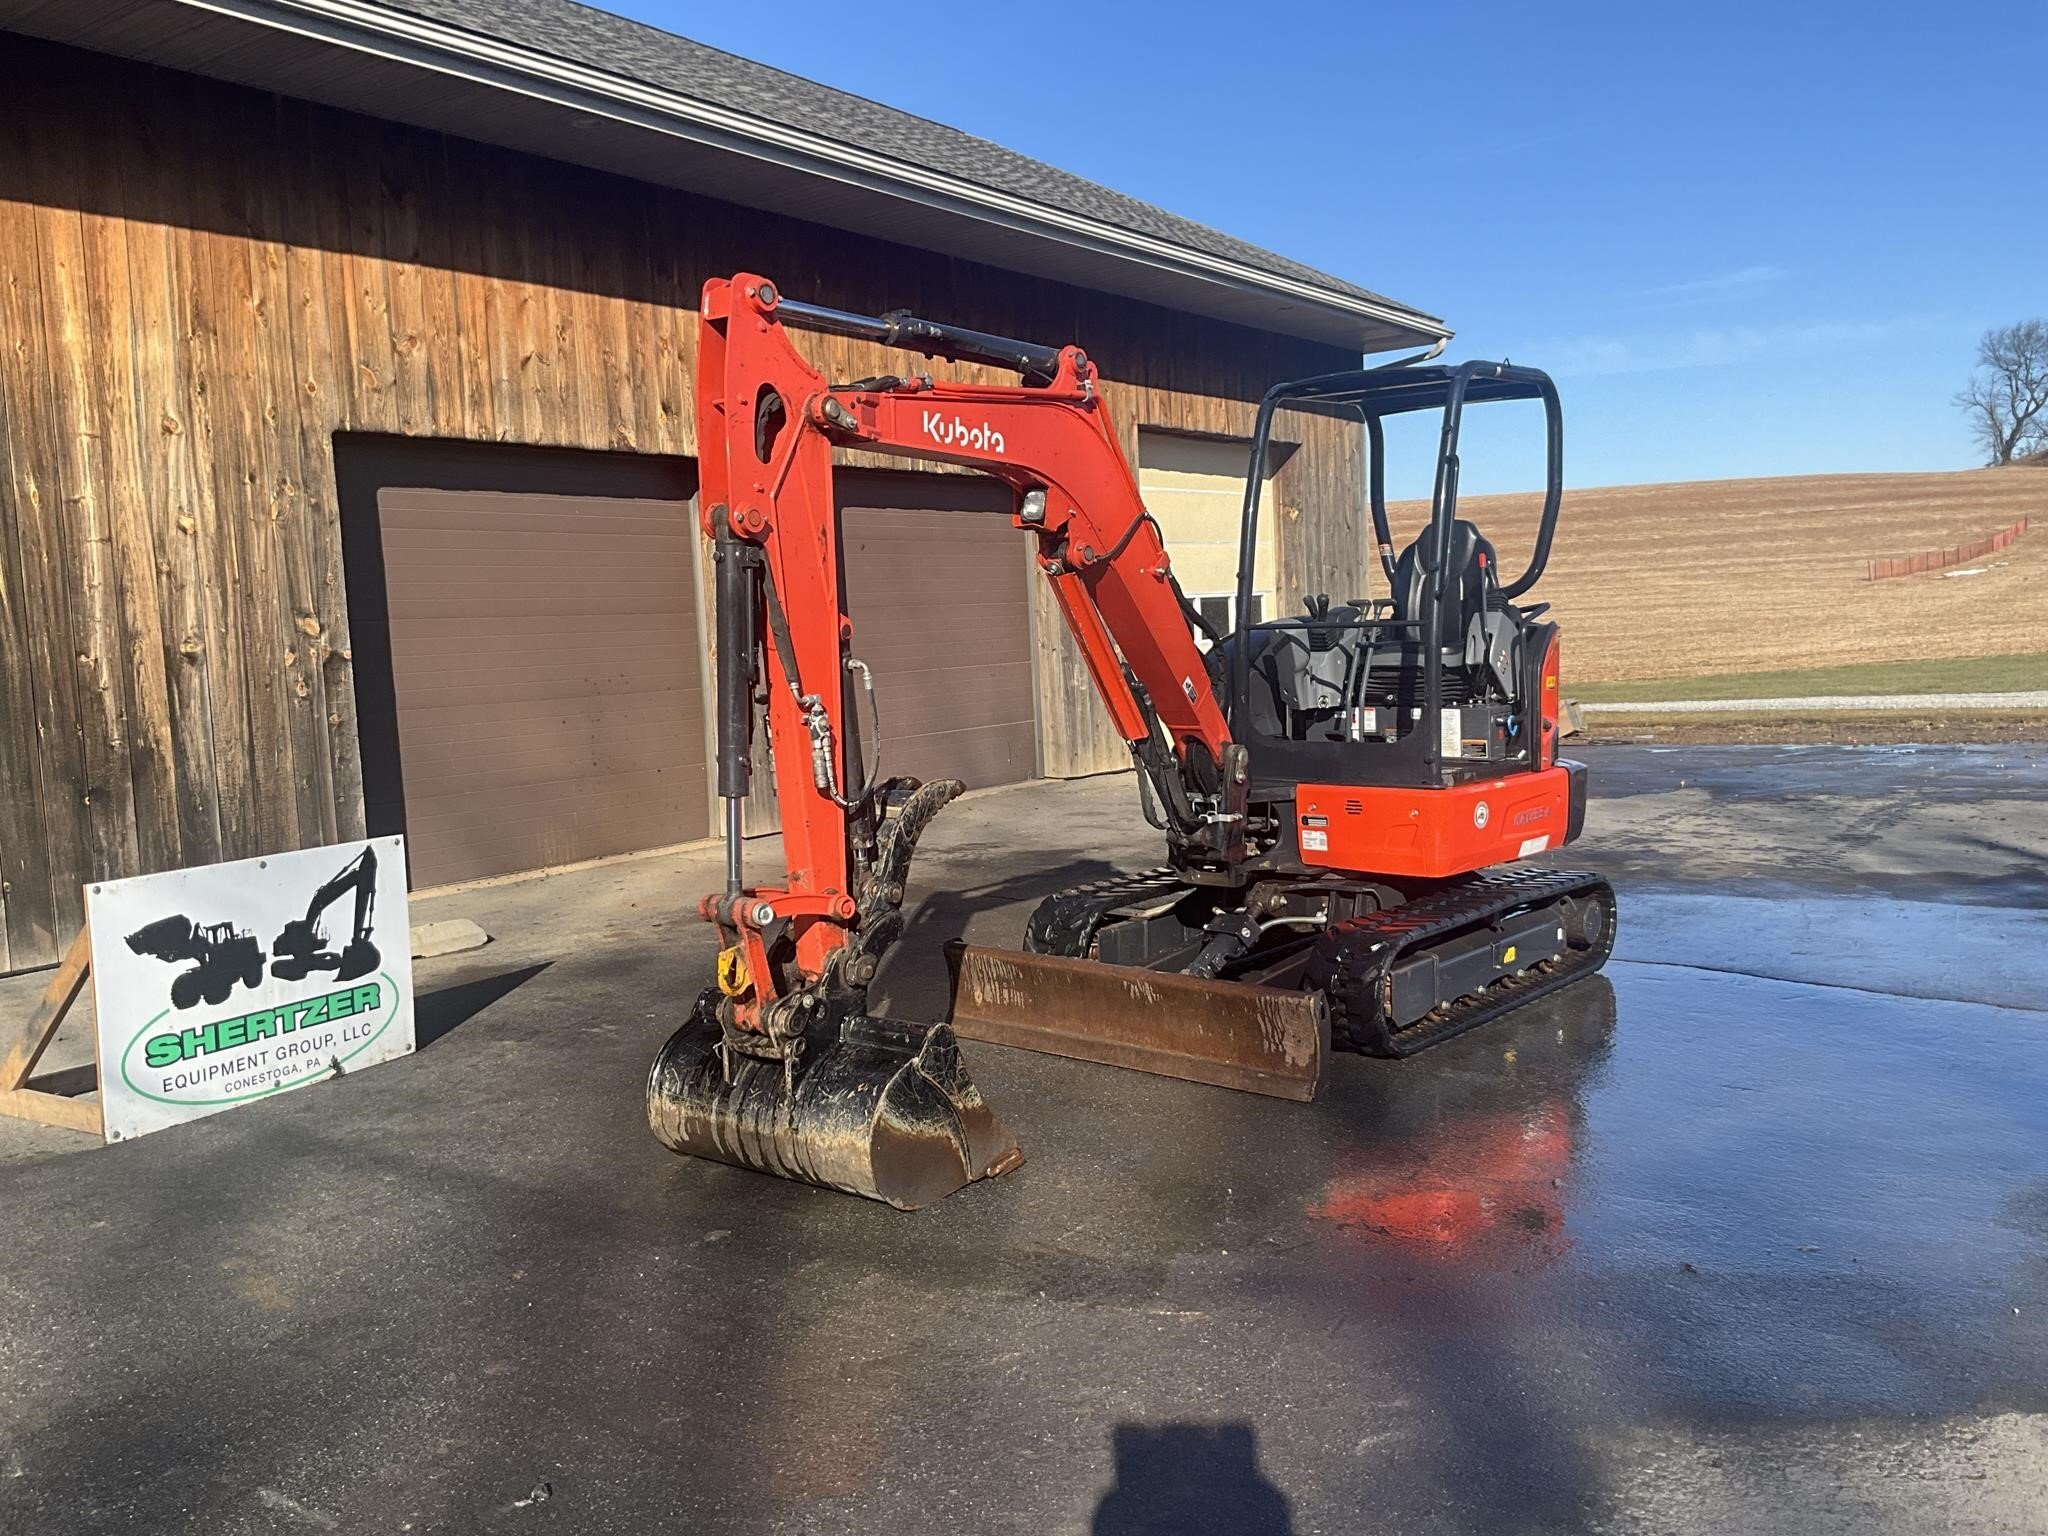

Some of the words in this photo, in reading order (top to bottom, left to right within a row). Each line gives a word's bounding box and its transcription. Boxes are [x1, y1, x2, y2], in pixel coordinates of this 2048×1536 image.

[923, 410, 1005, 454] Kubota
[145, 982, 381, 1068] SHERTZER
[162, 1050, 269, 1093] EQUIPMENT
[275, 1033, 337, 1061] GROUP,
[343, 1022, 372, 1042] LLC
[224, 1063, 302, 1093] CONESTOGA,
[306, 1057, 321, 1069] PA
